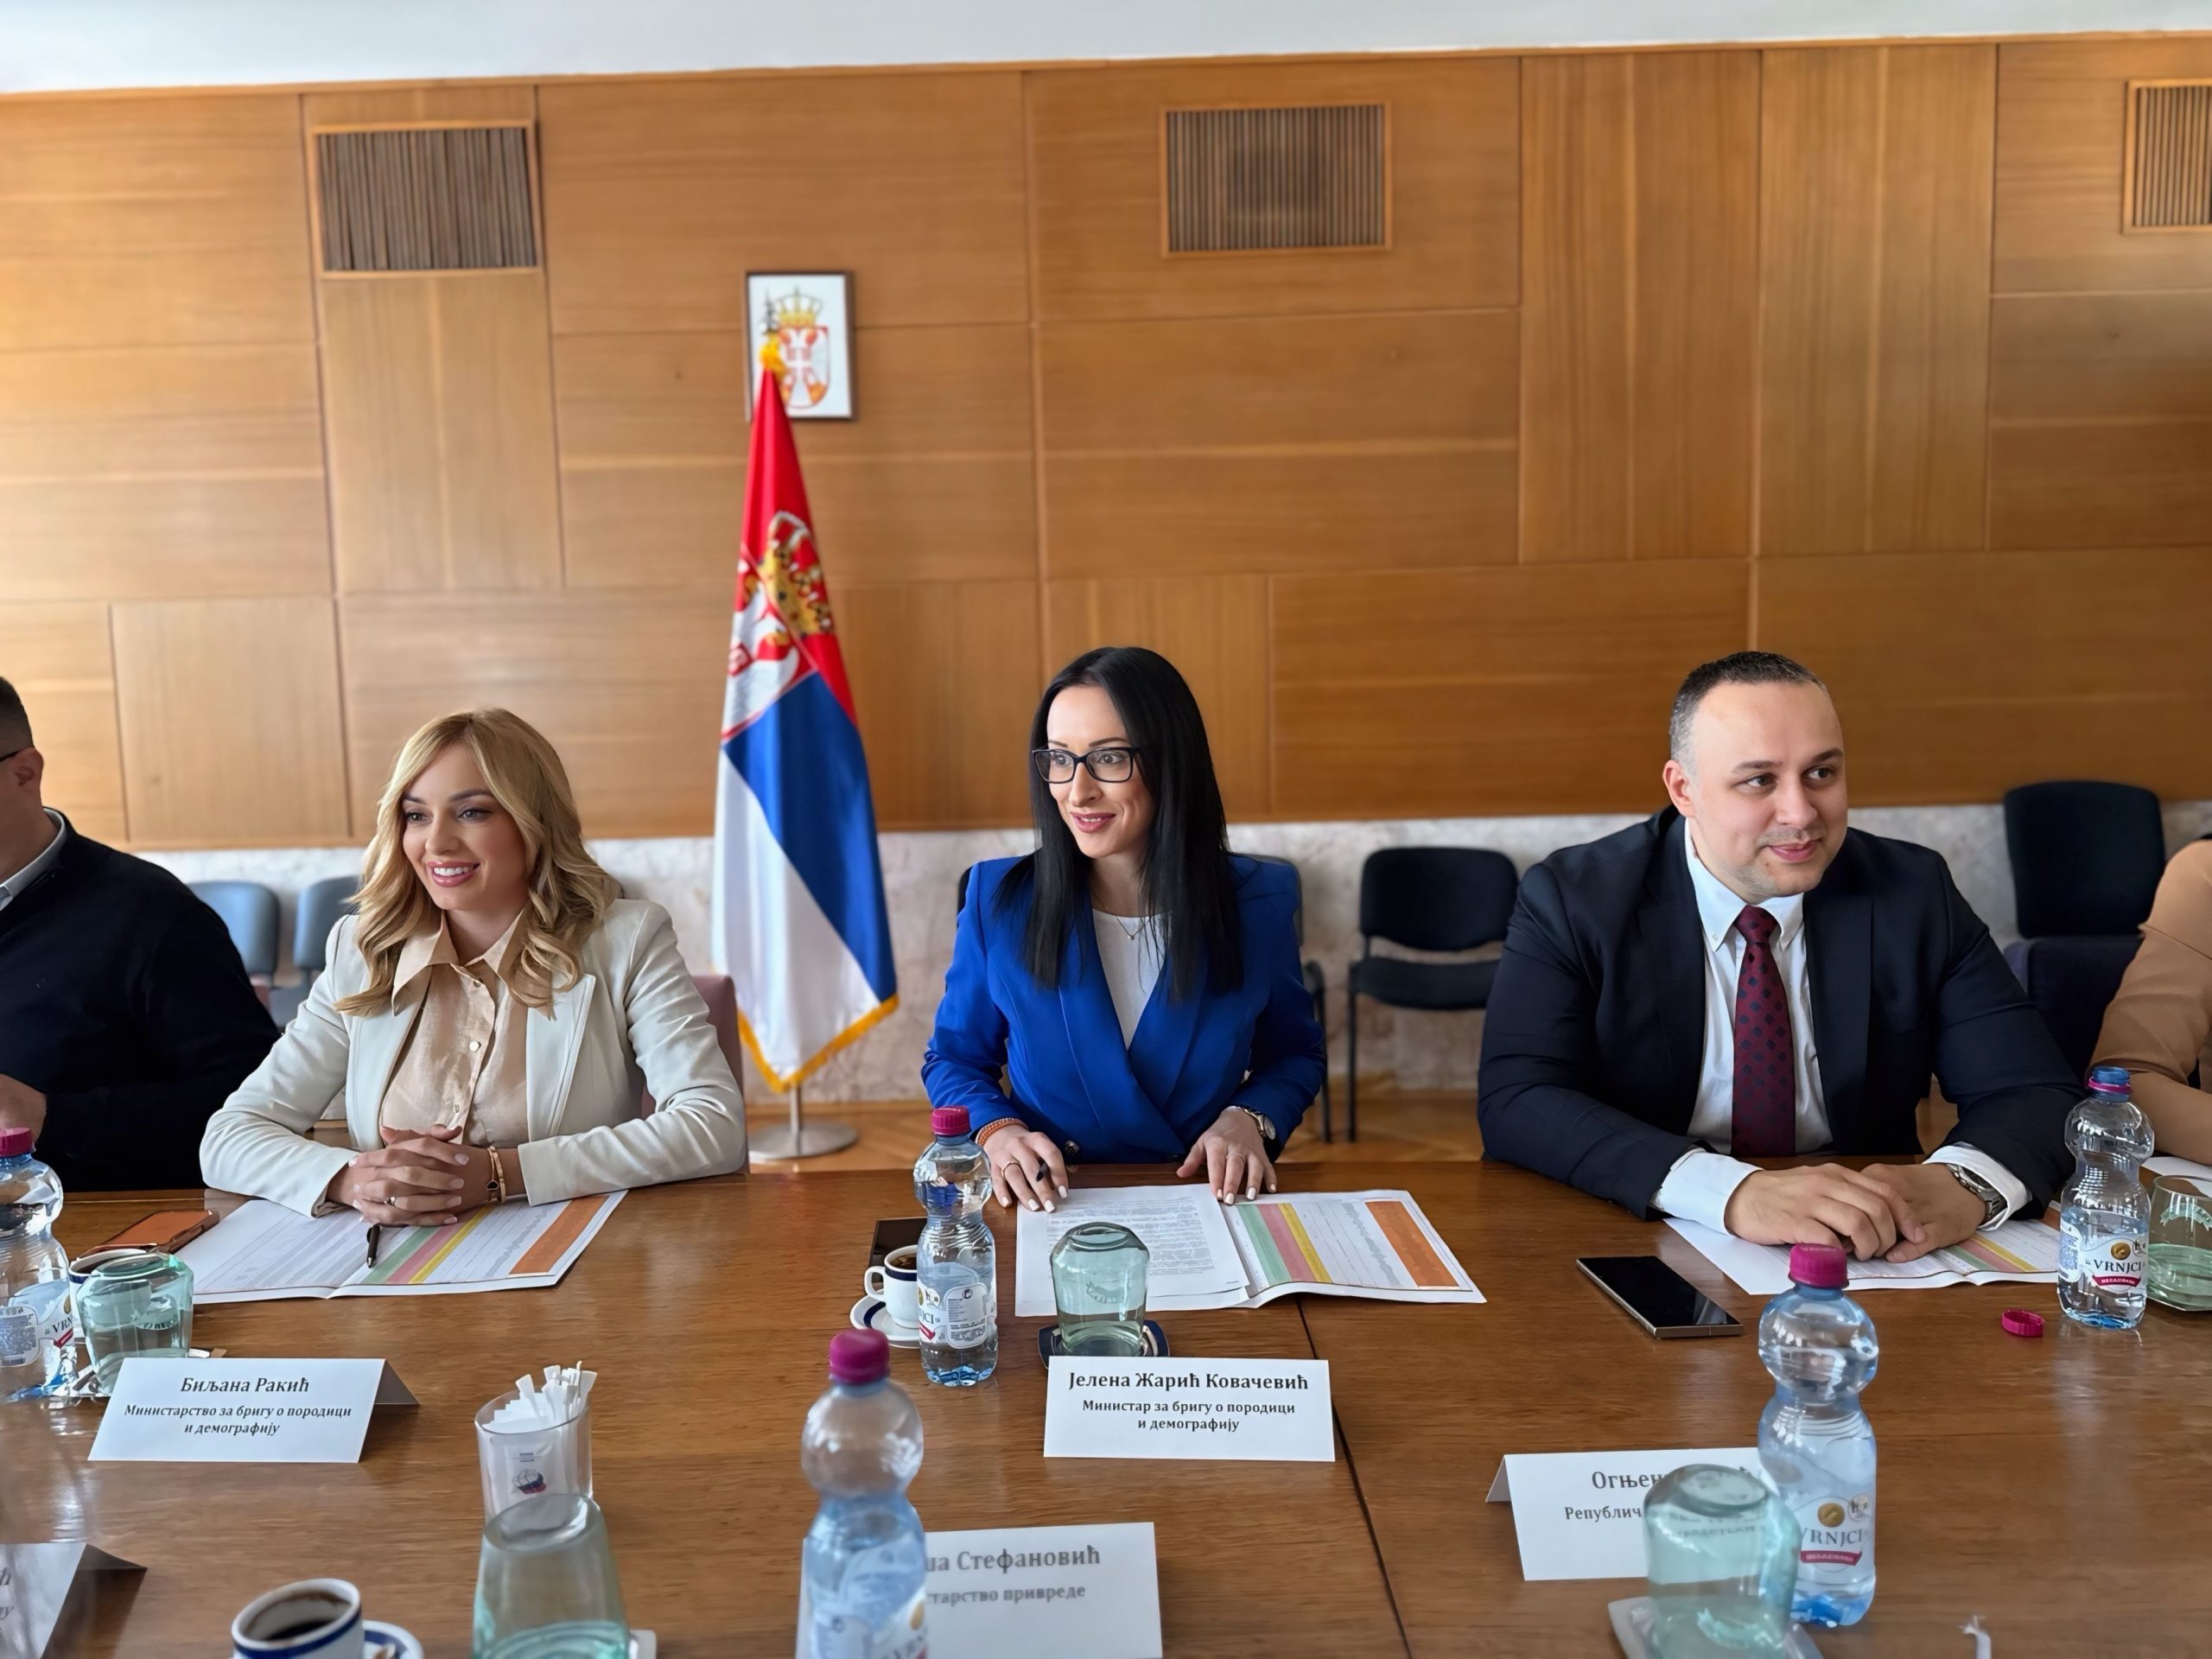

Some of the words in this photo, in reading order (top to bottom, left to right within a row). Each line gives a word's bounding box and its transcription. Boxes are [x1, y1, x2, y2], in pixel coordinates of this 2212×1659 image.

[2094, 1260, 2141, 1274] VRNJCI
[180, 1377, 250, 1392] Биљана
[255, 1377, 309, 1392] Ракић
[1068, 1372, 1130, 1390] Јелена
[1135, 1372, 1200, 1391] Жарић
[1206, 1374, 1309, 1389] Ковачевић
[124, 1405, 217, 1418] Министарство
[219, 1407, 232, 1416] за
[236, 1405, 275, 1419] бригу
[276, 1407, 284, 1416] о
[287, 1407, 352, 1418] породици
[1083, 1400, 1151, 1414] Министар
[1154, 1402, 1168, 1412] за
[1173, 1401, 1212, 1414] бригу
[1216, 1403, 1224, 1413] о
[1227, 1403, 1295, 1415] породици
[184, 1424, 194, 1433] и
[194, 1422, 281, 1436] демографију
[1138, 1419, 1147, 1428] и
[1150, 1418, 1240, 1433] демографију
[1565, 1505, 1643, 1522] Републич
[957, 1544, 1101, 1573] Стефановић
[927, 1589, 999, 1607] тарство
[1003, 1586, 1086, 1604] привреде
